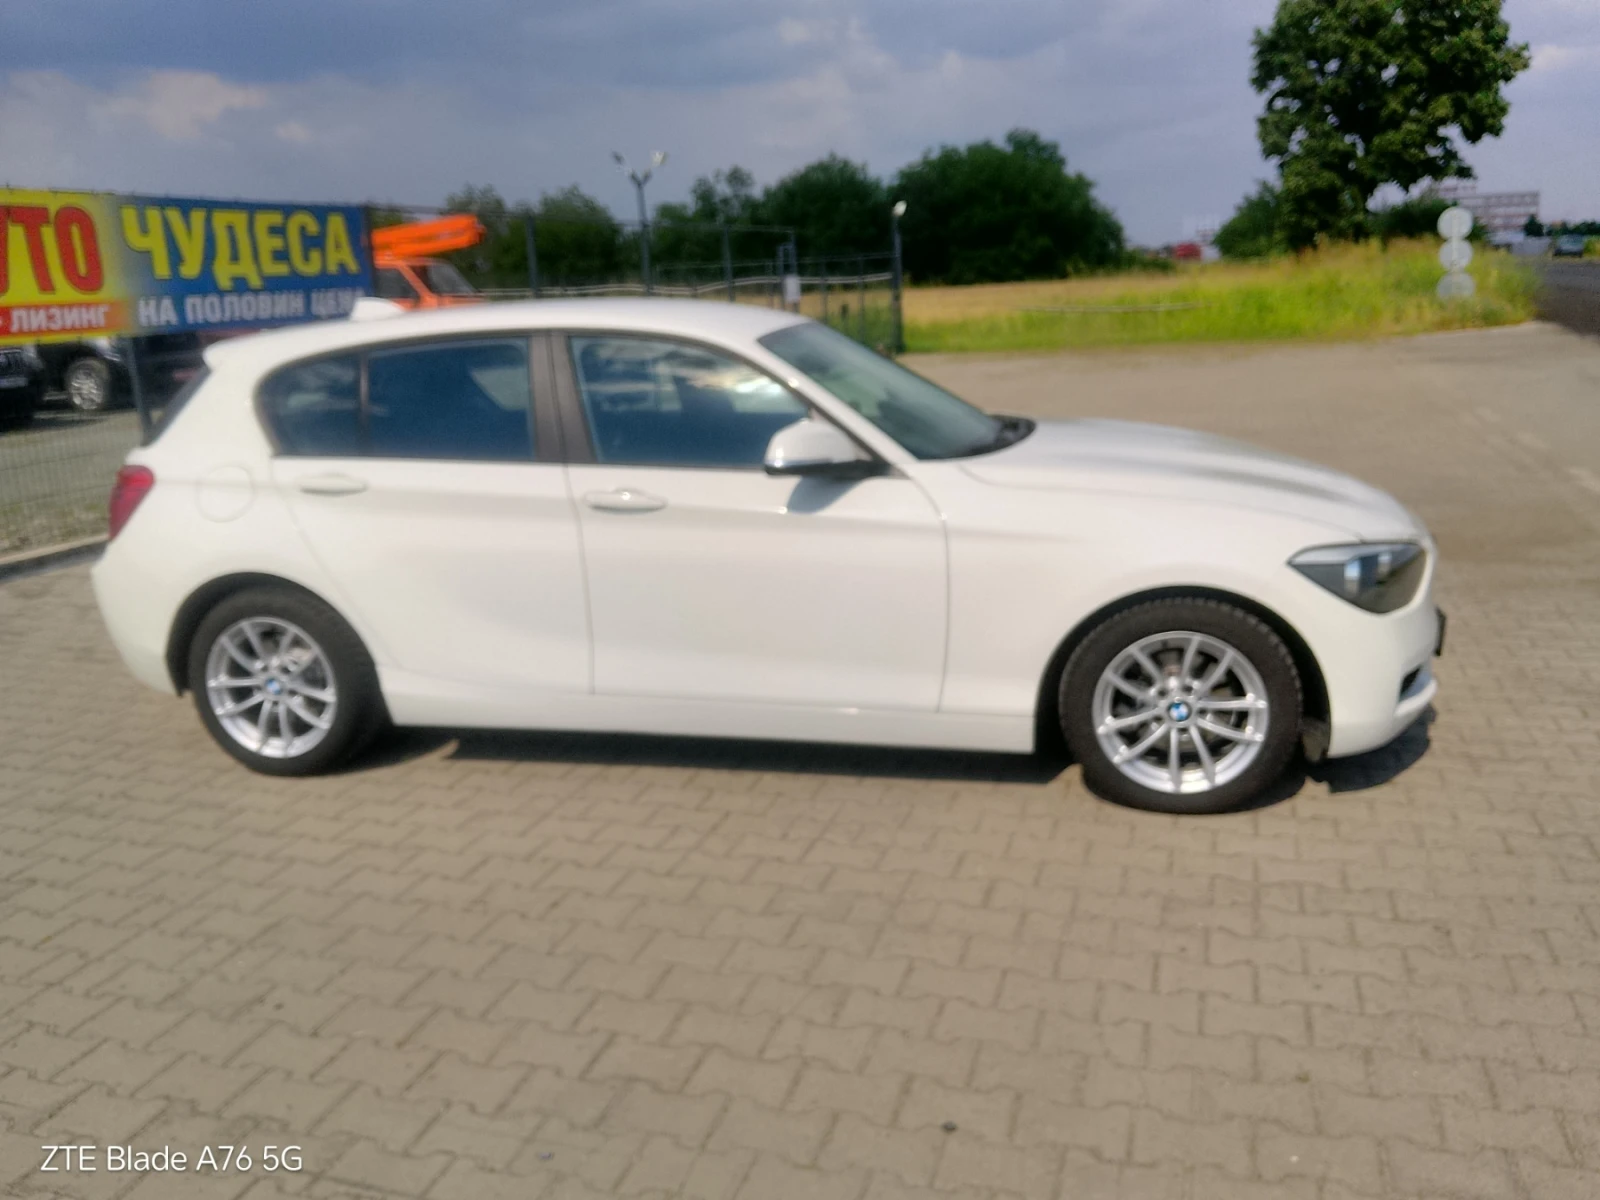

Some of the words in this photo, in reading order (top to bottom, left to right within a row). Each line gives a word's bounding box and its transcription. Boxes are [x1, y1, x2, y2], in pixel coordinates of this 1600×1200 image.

[0, 205, 104, 295] ТО
[119, 204, 361, 291] ЧУДЕСА
[10, 303, 111, 333] ЛИЗИНГ
[137, 295, 179, 327] НА
[184, 289, 305, 325] ПОЛОВИН
